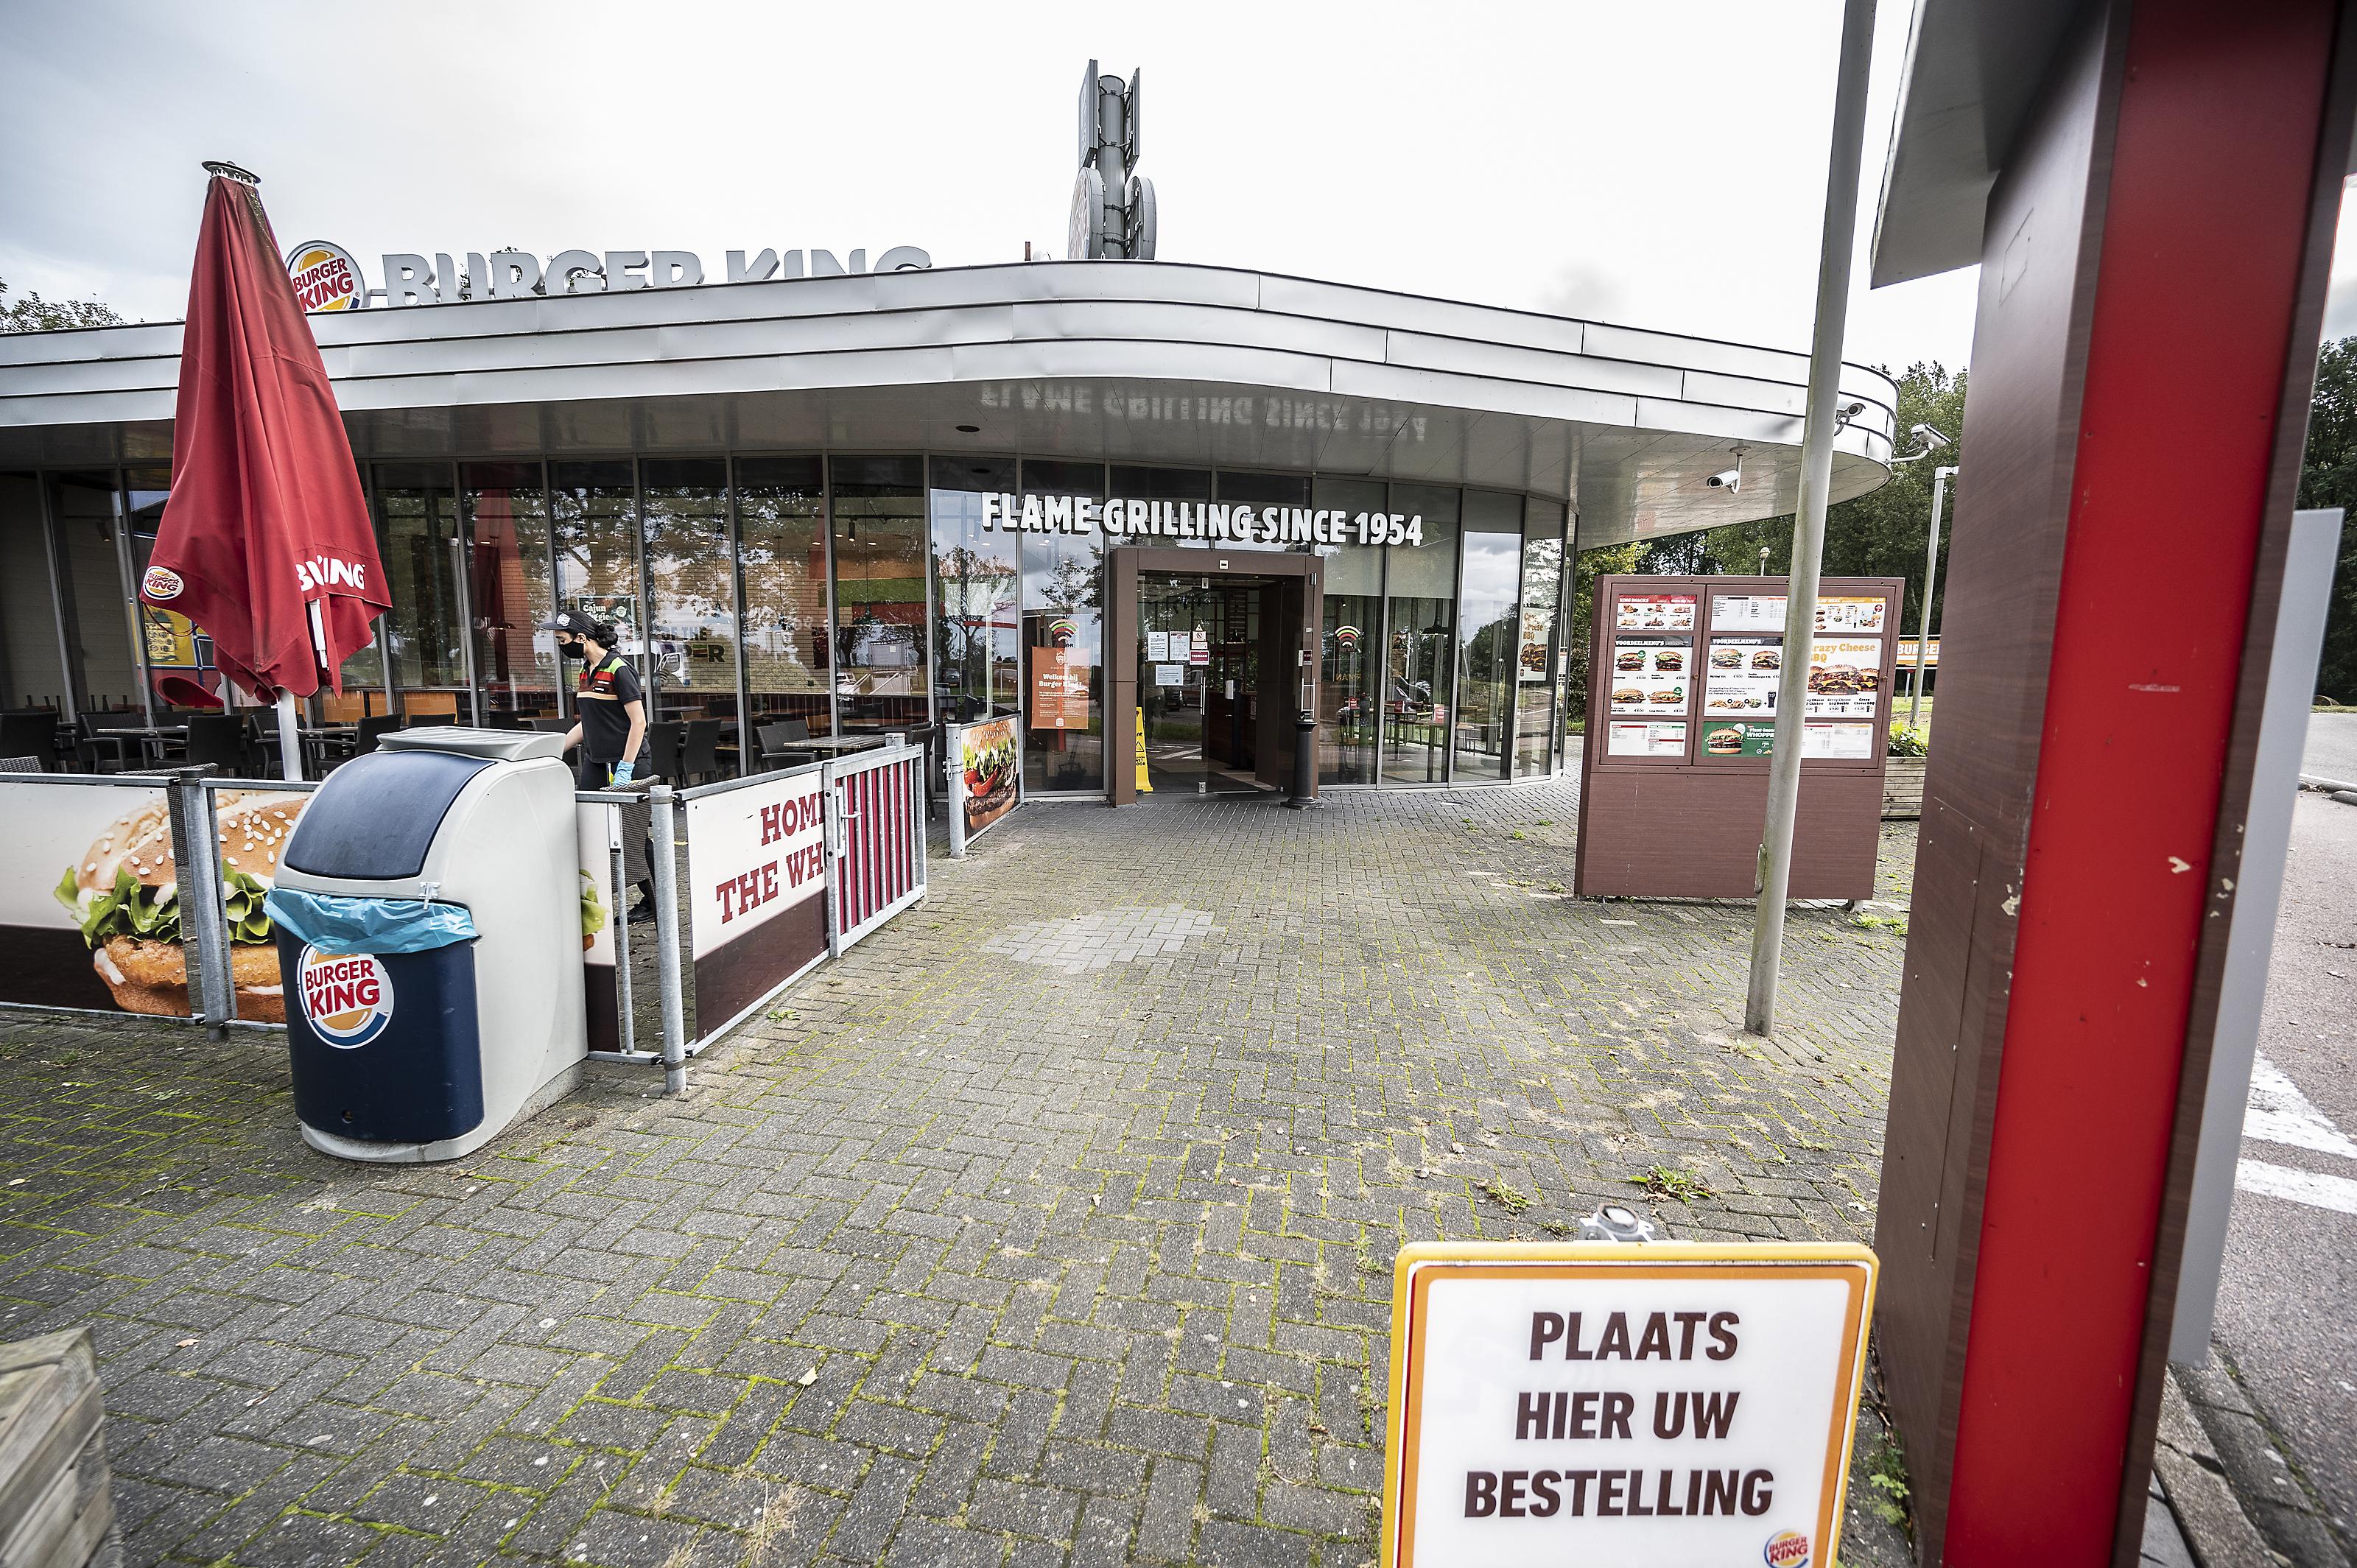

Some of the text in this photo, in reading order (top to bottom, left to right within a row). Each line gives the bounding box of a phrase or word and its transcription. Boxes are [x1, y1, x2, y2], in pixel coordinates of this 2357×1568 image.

[292, 258, 348, 292] BURGER
[382, 250, 703, 306] BURGER
[298, 273, 354, 312] KING
[981, 491, 1423, 546] FLAME GRILLING SINCE 1954
[146, 577, 179, 591] KING
[583, 604, 607, 614] Cajun
[1811, 653, 1827, 663] BQ
[1812, 643, 1875, 654] razy Cheese
[1039, 681, 1063, 689] Burger
[716, 859, 778, 925] THE
[305, 959, 375, 991] BURGER
[309, 978, 380, 1019] KING
[1529, 1311, 1740, 1361] PLAATS
[1514, 1391, 1740, 1441] HIER UW
[1464, 1469, 1774, 1519] BESTELLING
[1769, 1536, 1807, 1553] BURGER
[1770, 1544, 1808, 1564] KING
